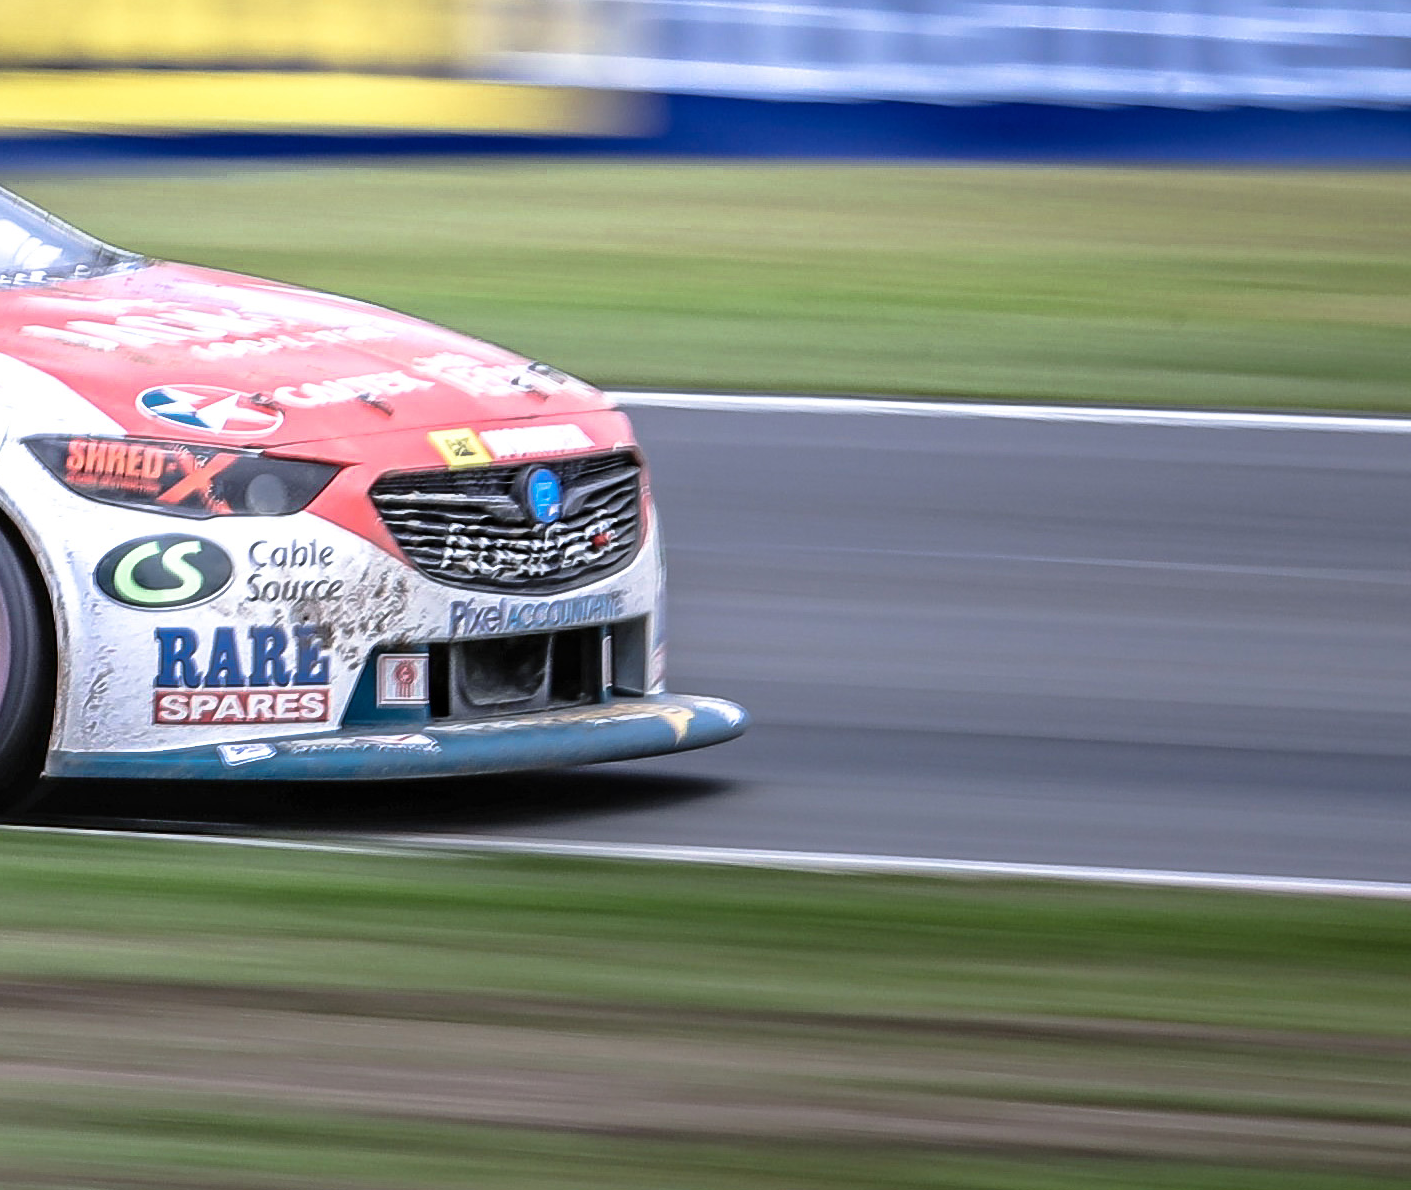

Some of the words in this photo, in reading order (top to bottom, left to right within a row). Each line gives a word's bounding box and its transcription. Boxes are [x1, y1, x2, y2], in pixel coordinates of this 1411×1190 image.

[113, 540, 205, 604] CS
[247, 540, 334, 569] Cable
[246, 575, 343, 604] Source
[449, 594, 507, 636] Pixel
[154, 626, 331, 689] RARE
[156, 690, 329, 723] SPARES
